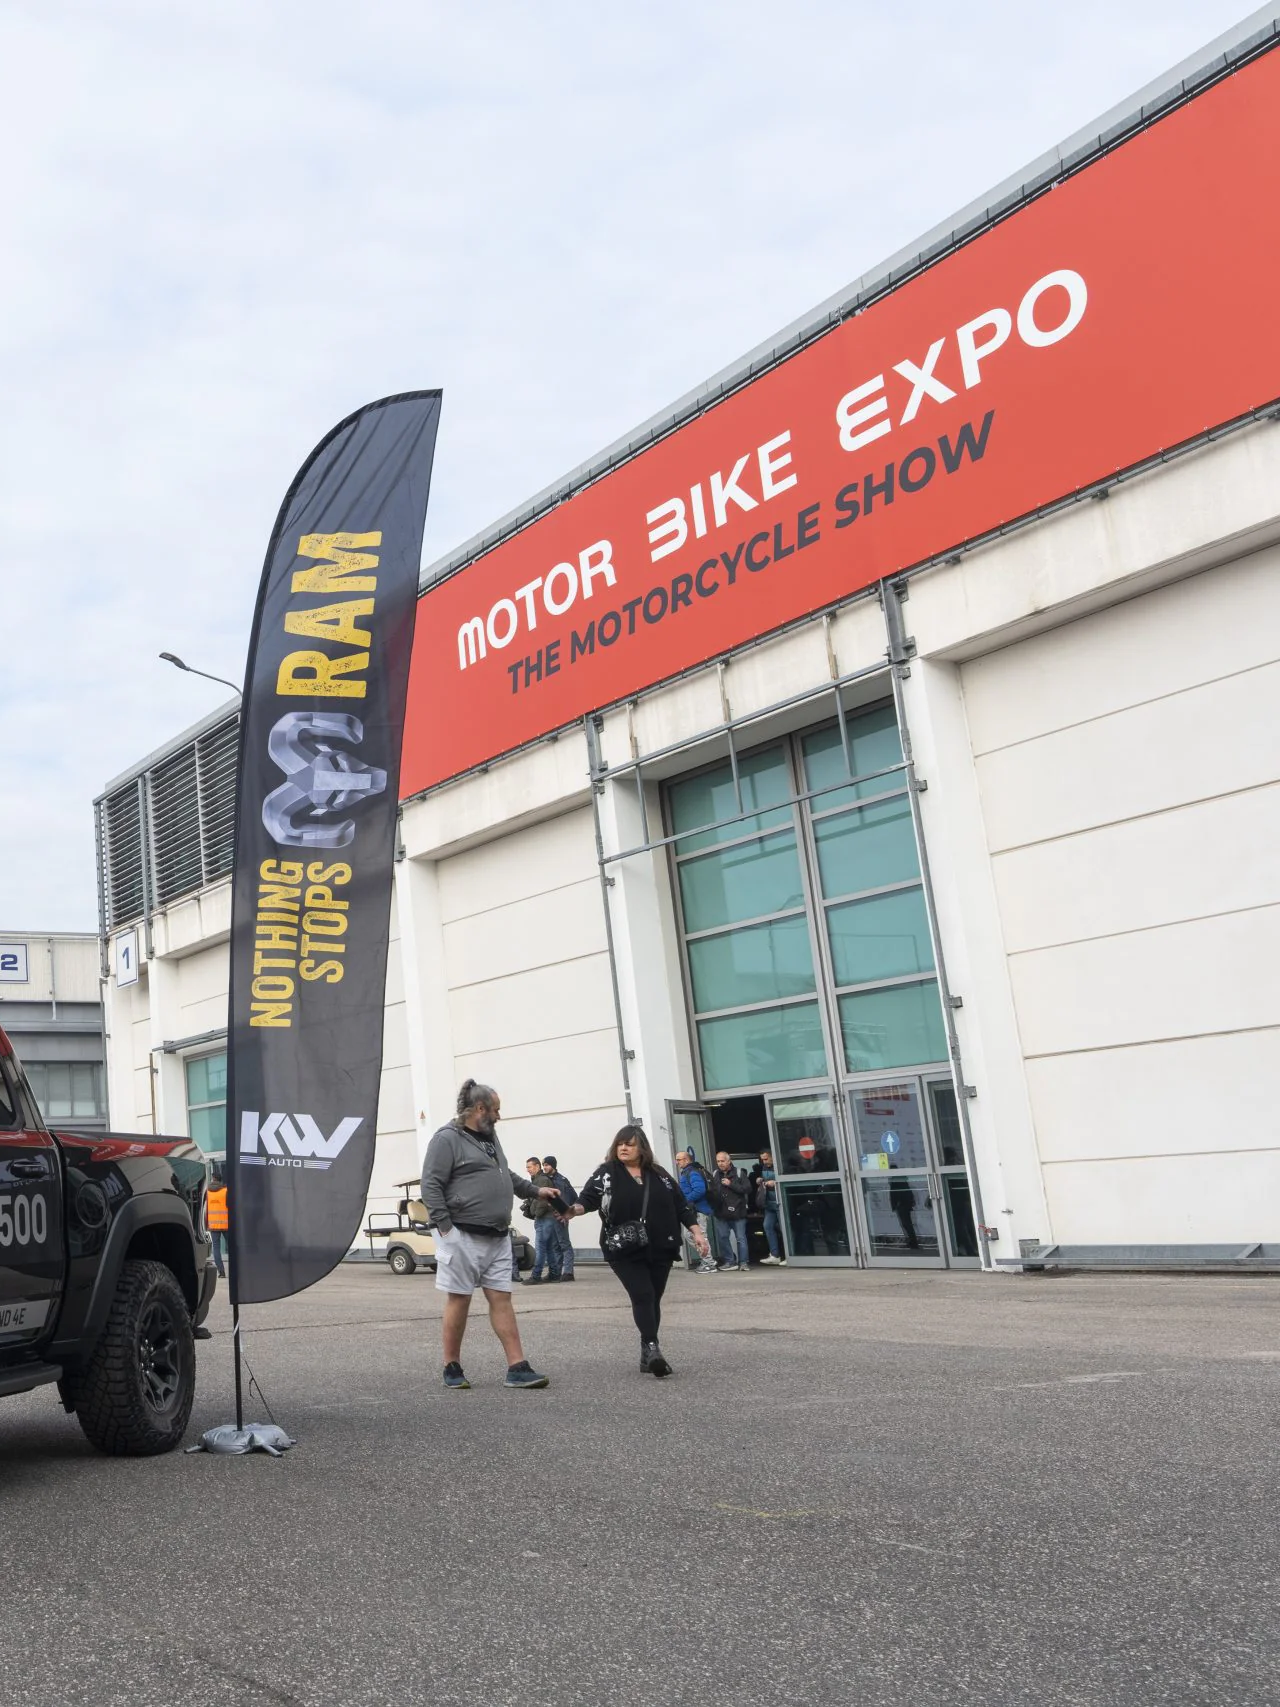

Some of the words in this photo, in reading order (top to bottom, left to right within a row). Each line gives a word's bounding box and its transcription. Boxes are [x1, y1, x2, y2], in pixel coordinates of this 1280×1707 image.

[457, 540, 617, 671] MOTOR
[646, 429, 798, 563] BIKE
[835, 269, 1088, 452] EXPO
[507, 639, 561, 695] THE
[571, 501, 821, 665] MOTORCYCLE
[834, 409, 995, 529] SHOW
[276, 531, 382, 698] RAM
[0, 953, 19, 971] 2
[122, 946, 131, 970] 1
[249, 859, 304, 1028] NOTHING
[298, 861, 353, 983] STOPS
[268, 1158, 302, 1168] AUTO
[12, 1307, 27, 1326] 4E
